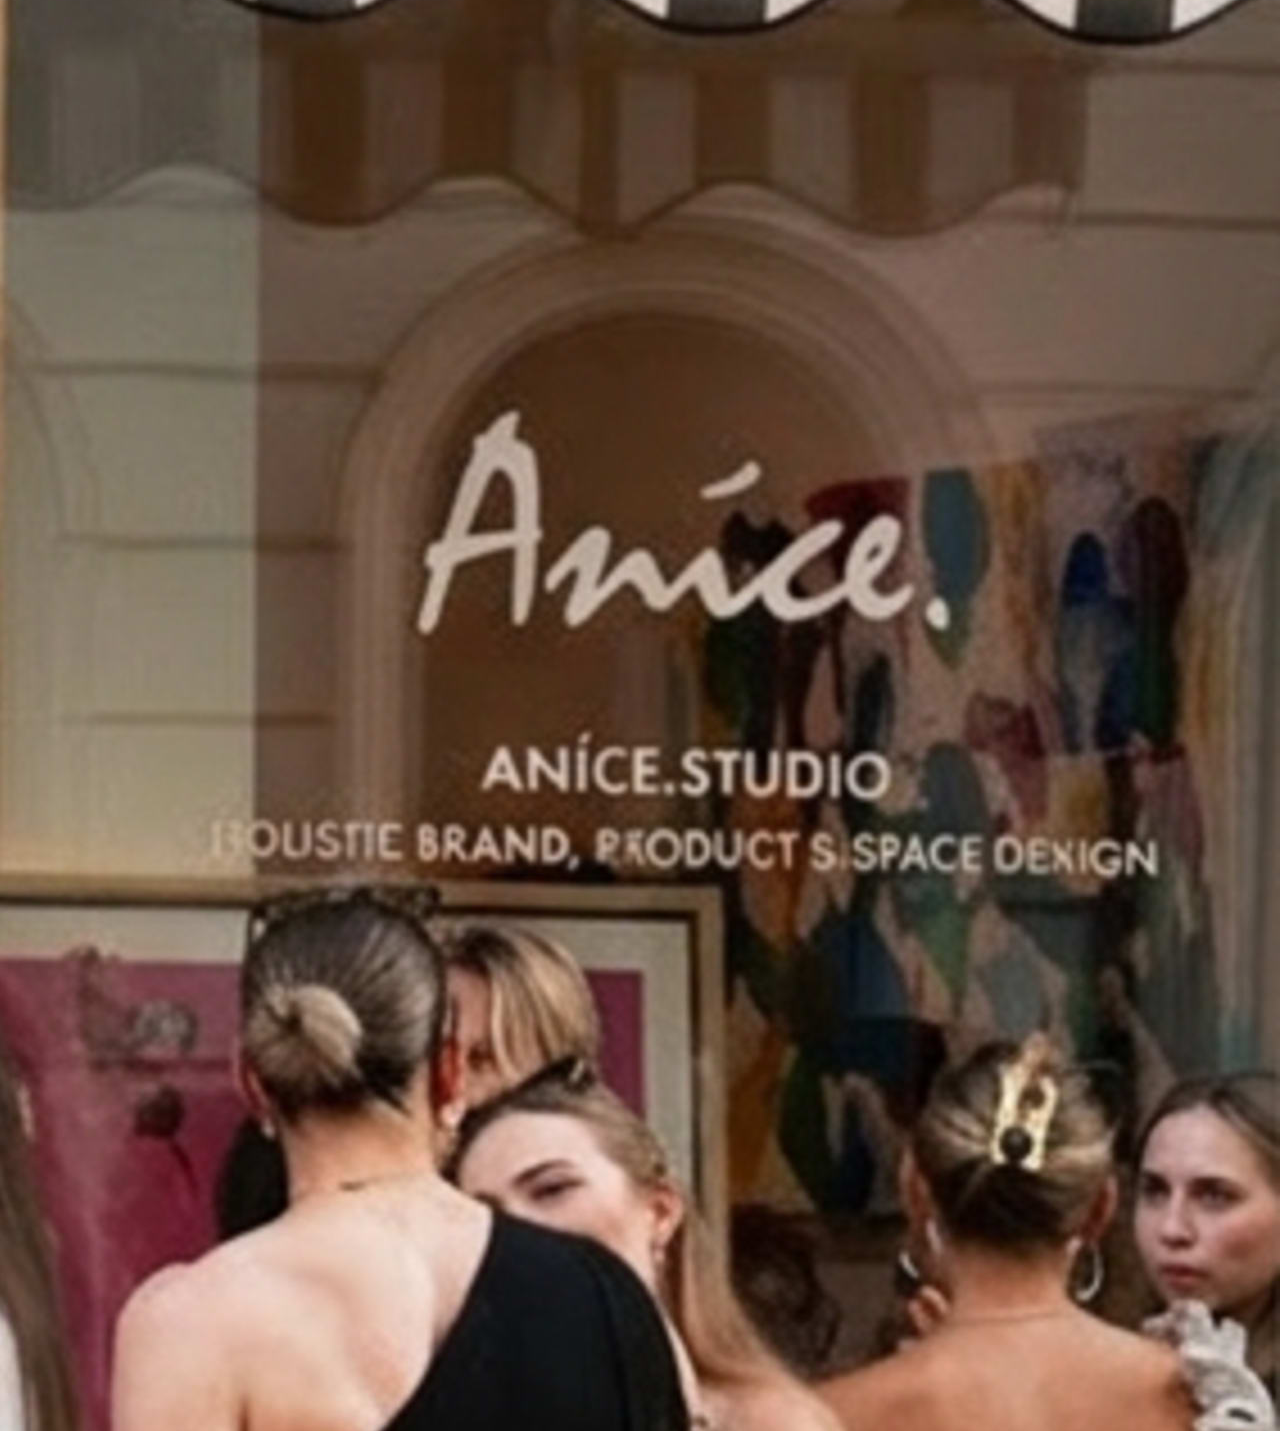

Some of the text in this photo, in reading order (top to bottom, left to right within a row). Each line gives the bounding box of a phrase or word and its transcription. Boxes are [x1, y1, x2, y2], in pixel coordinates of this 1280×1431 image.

[480, 731, 893, 800] ANÍCE.STUDIO
[416, 823, 581, 872] BRAND,
[852, 832, 983, 872] SPACE
